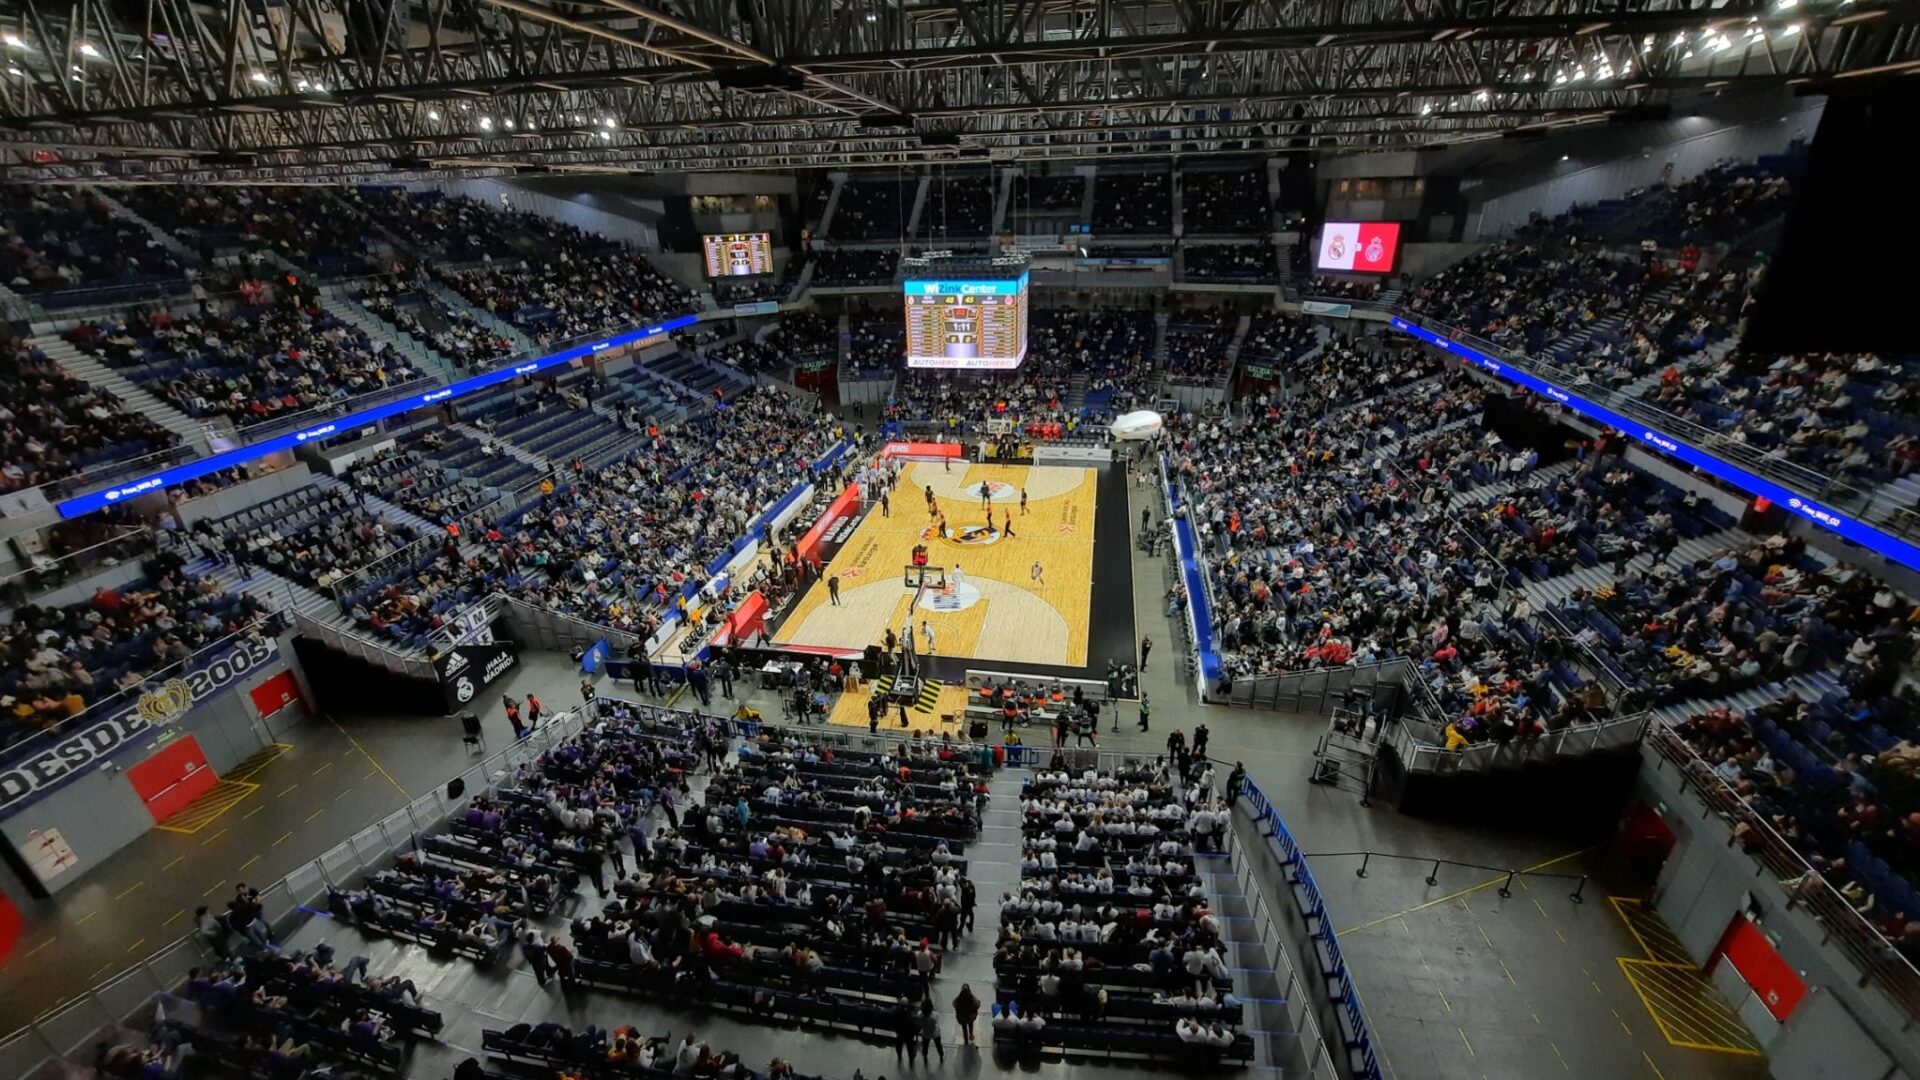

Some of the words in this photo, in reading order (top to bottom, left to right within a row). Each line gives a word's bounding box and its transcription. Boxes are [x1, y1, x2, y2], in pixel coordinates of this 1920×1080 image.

[953, 323, 970, 331] 1:11
[445, 657, 468, 677] adidas
[482, 655, 514, 684] MADRID!
[485, 651, 508, 674] ¡HALA
[0, 704, 151, 806] DESDE
[189, 637, 276, 701] 2005
